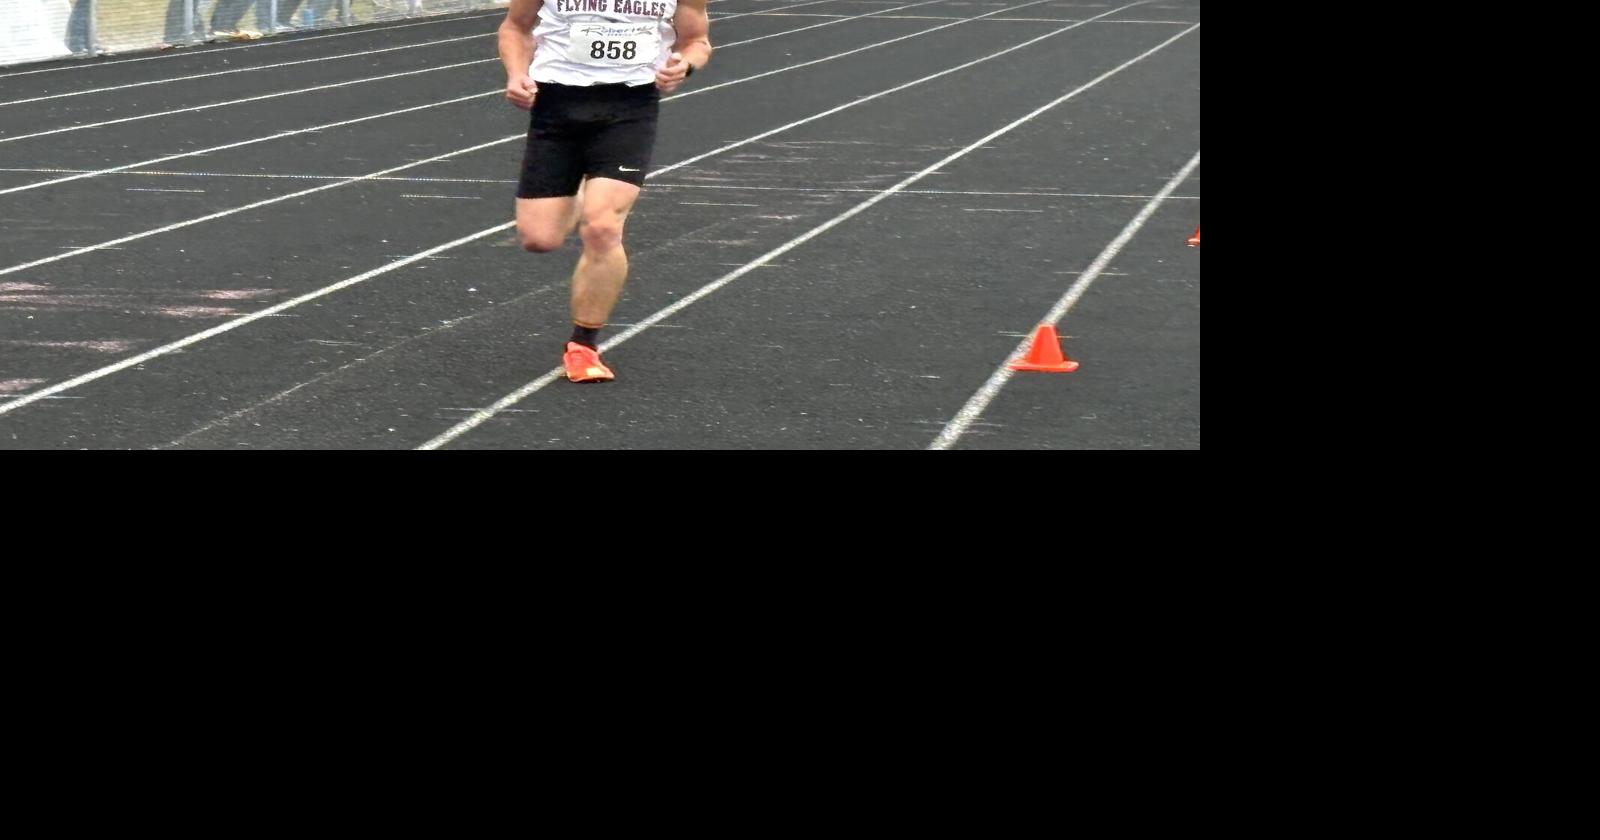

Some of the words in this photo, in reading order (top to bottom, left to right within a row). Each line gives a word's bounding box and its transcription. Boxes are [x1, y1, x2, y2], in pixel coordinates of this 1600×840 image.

[557, 0, 608, 12] FLYING
[613, 0, 666, 17] EAGLES
[590, 40, 637, 60] 858
